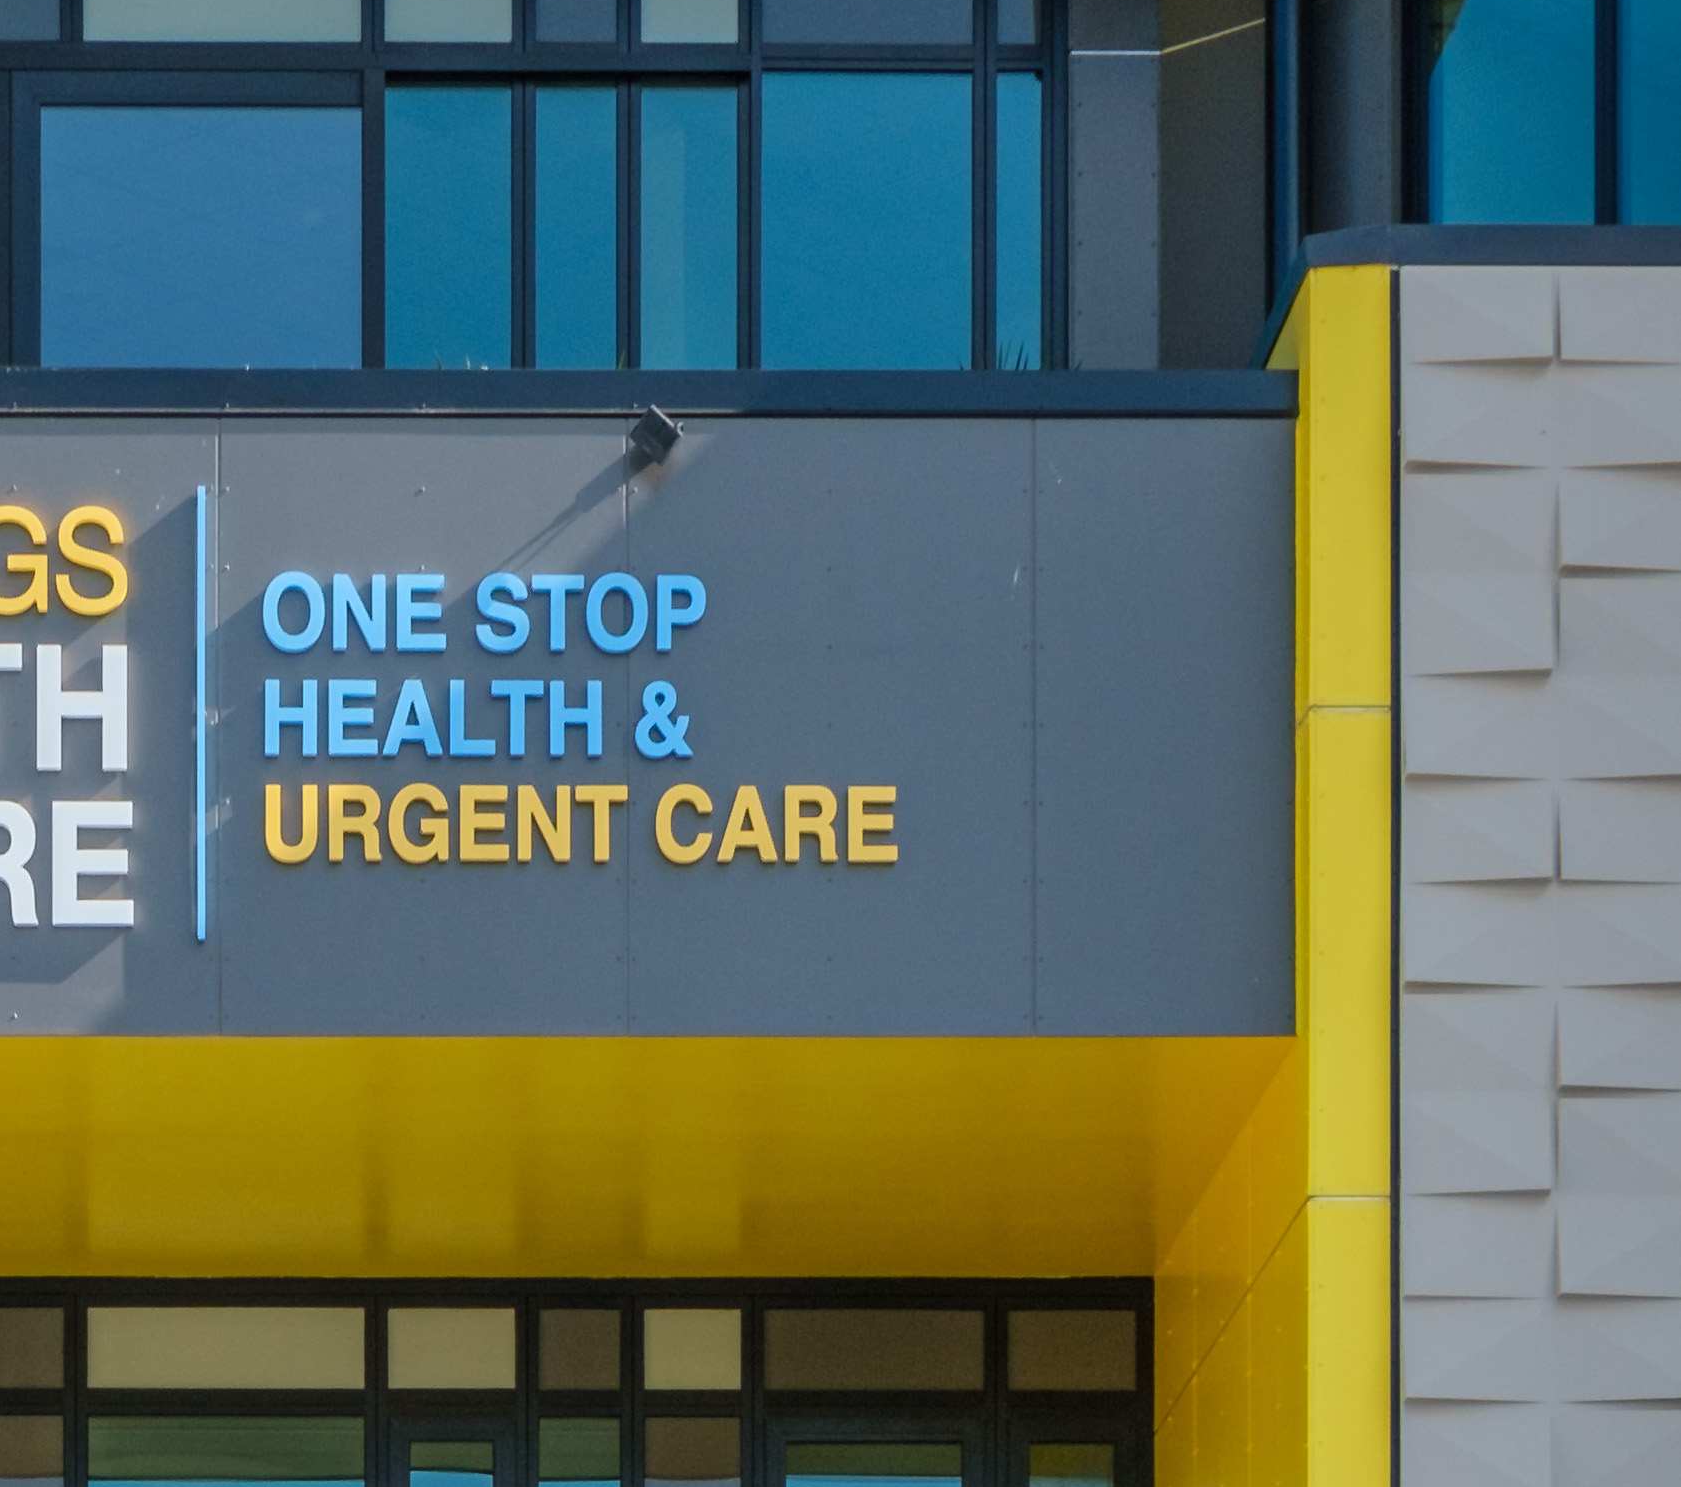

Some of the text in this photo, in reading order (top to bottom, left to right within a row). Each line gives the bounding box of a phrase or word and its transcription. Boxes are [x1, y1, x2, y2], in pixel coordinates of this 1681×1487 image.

[262, 571, 708, 656] ONE STOP
[263, 679, 694, 761] HEALTH &
[263, 783, 900, 866] URGENT CARE
